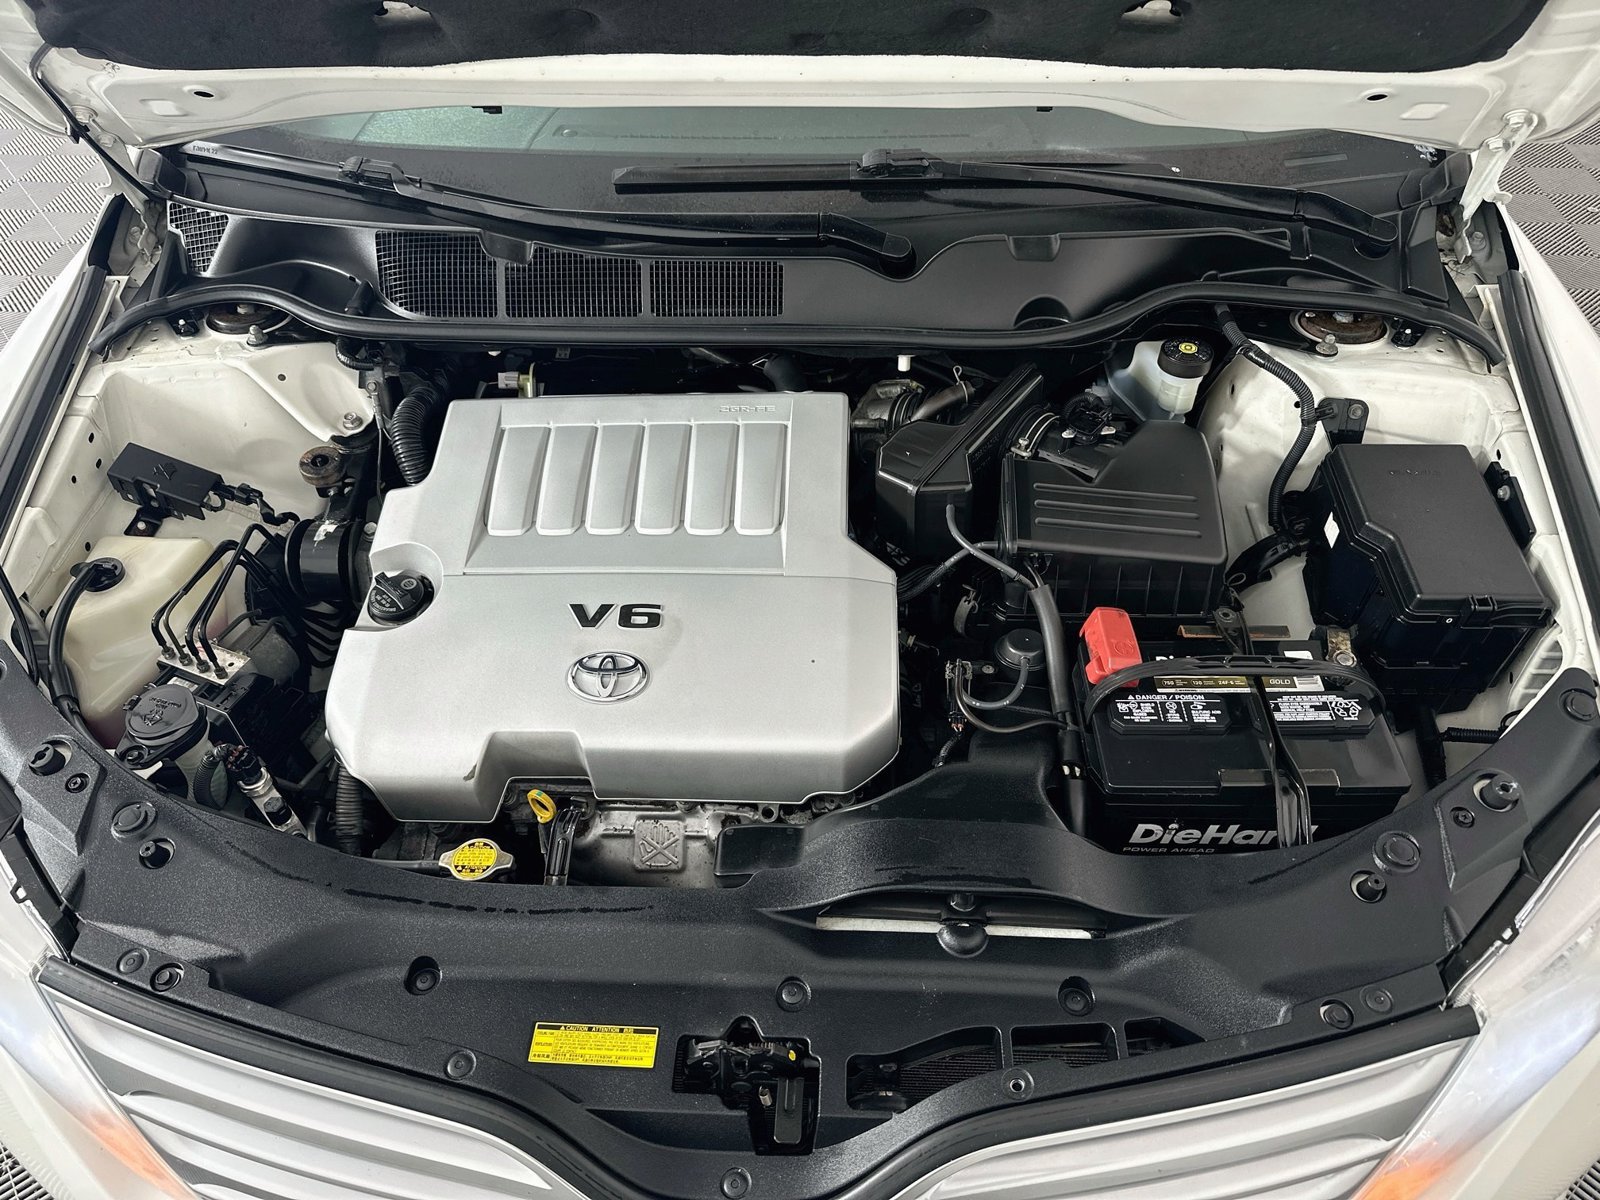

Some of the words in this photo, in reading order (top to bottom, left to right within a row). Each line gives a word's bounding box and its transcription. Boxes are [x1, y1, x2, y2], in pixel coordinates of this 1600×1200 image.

[719, 404, 777, 413] 2GR-FE
[568, 603, 663, 630] V6
[1129, 823, 1318, 845] DieHar
